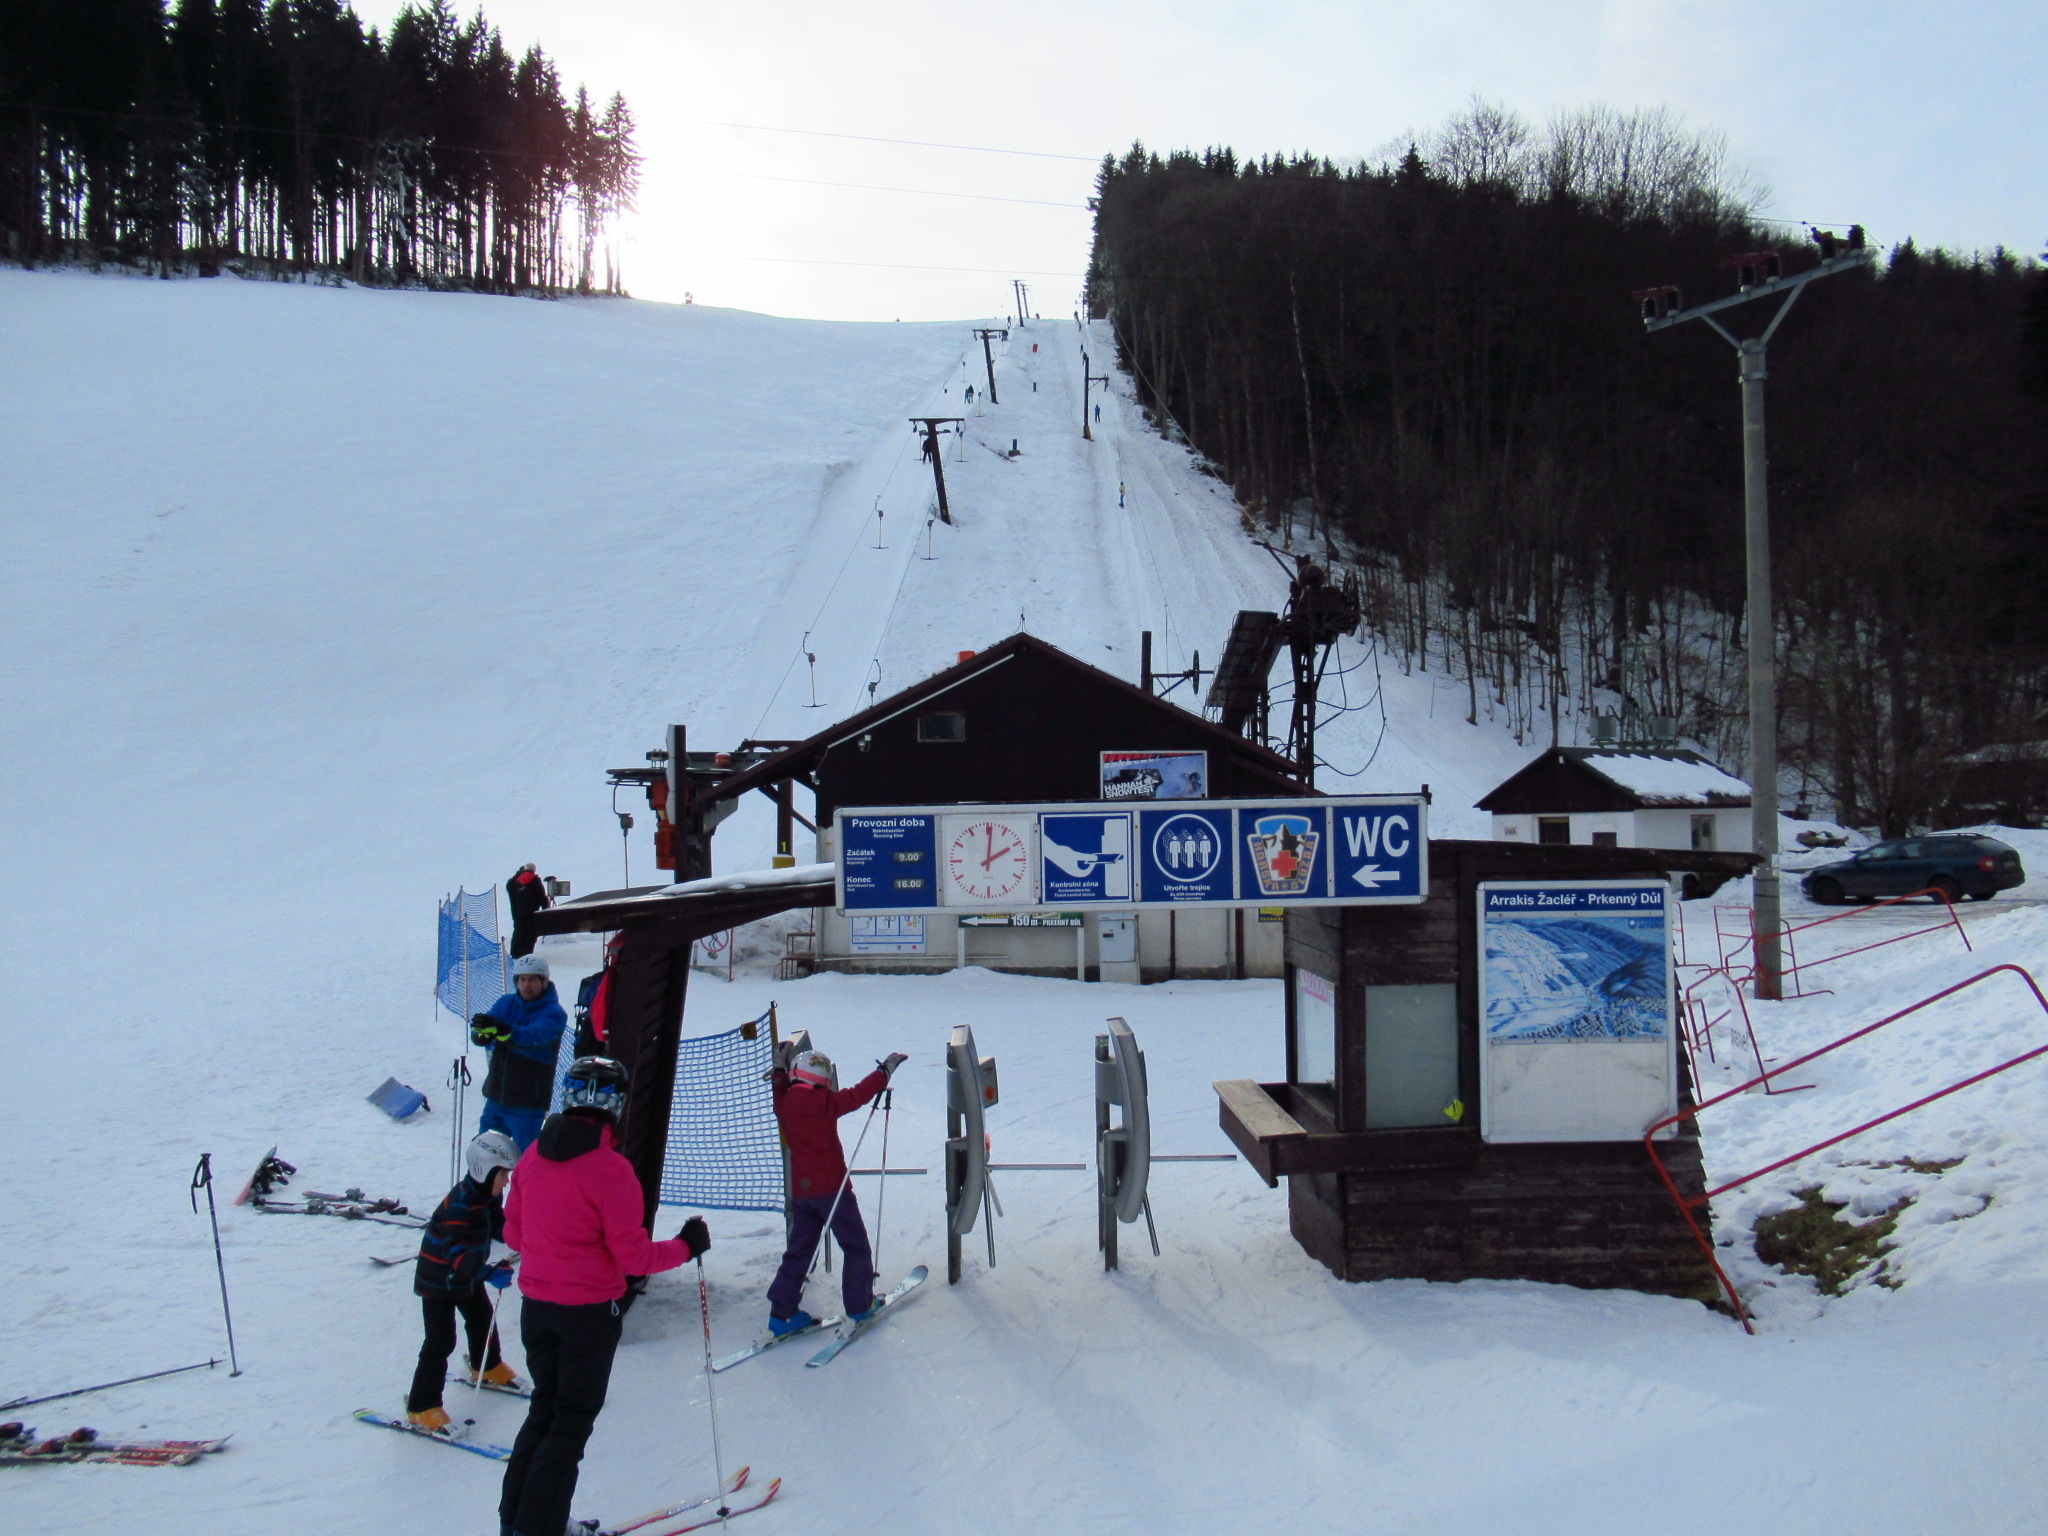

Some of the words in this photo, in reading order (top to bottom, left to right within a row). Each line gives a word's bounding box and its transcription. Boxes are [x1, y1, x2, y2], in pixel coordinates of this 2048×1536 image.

[1105, 781, 1143, 792] HANNAH
[1106, 784, 1154, 798] SNOWTEST
[852, 818, 897, 828] Provozní
[899, 818, 925, 827] doba
[1343, 815, 1410, 858] WC
[780, 841, 786, 852] 1
[899, 853, 919, 861] 9.00
[897, 880, 921, 888] 16.00
[1490, 894, 1534, 905] Arrakis
[1537, 892, 1577, 905] Žacléř
[1588, 893, 1637, 906] Prkenný
[1640, 891, 1661, 904] Důl
[1012, 915, 1029, 926] 150
